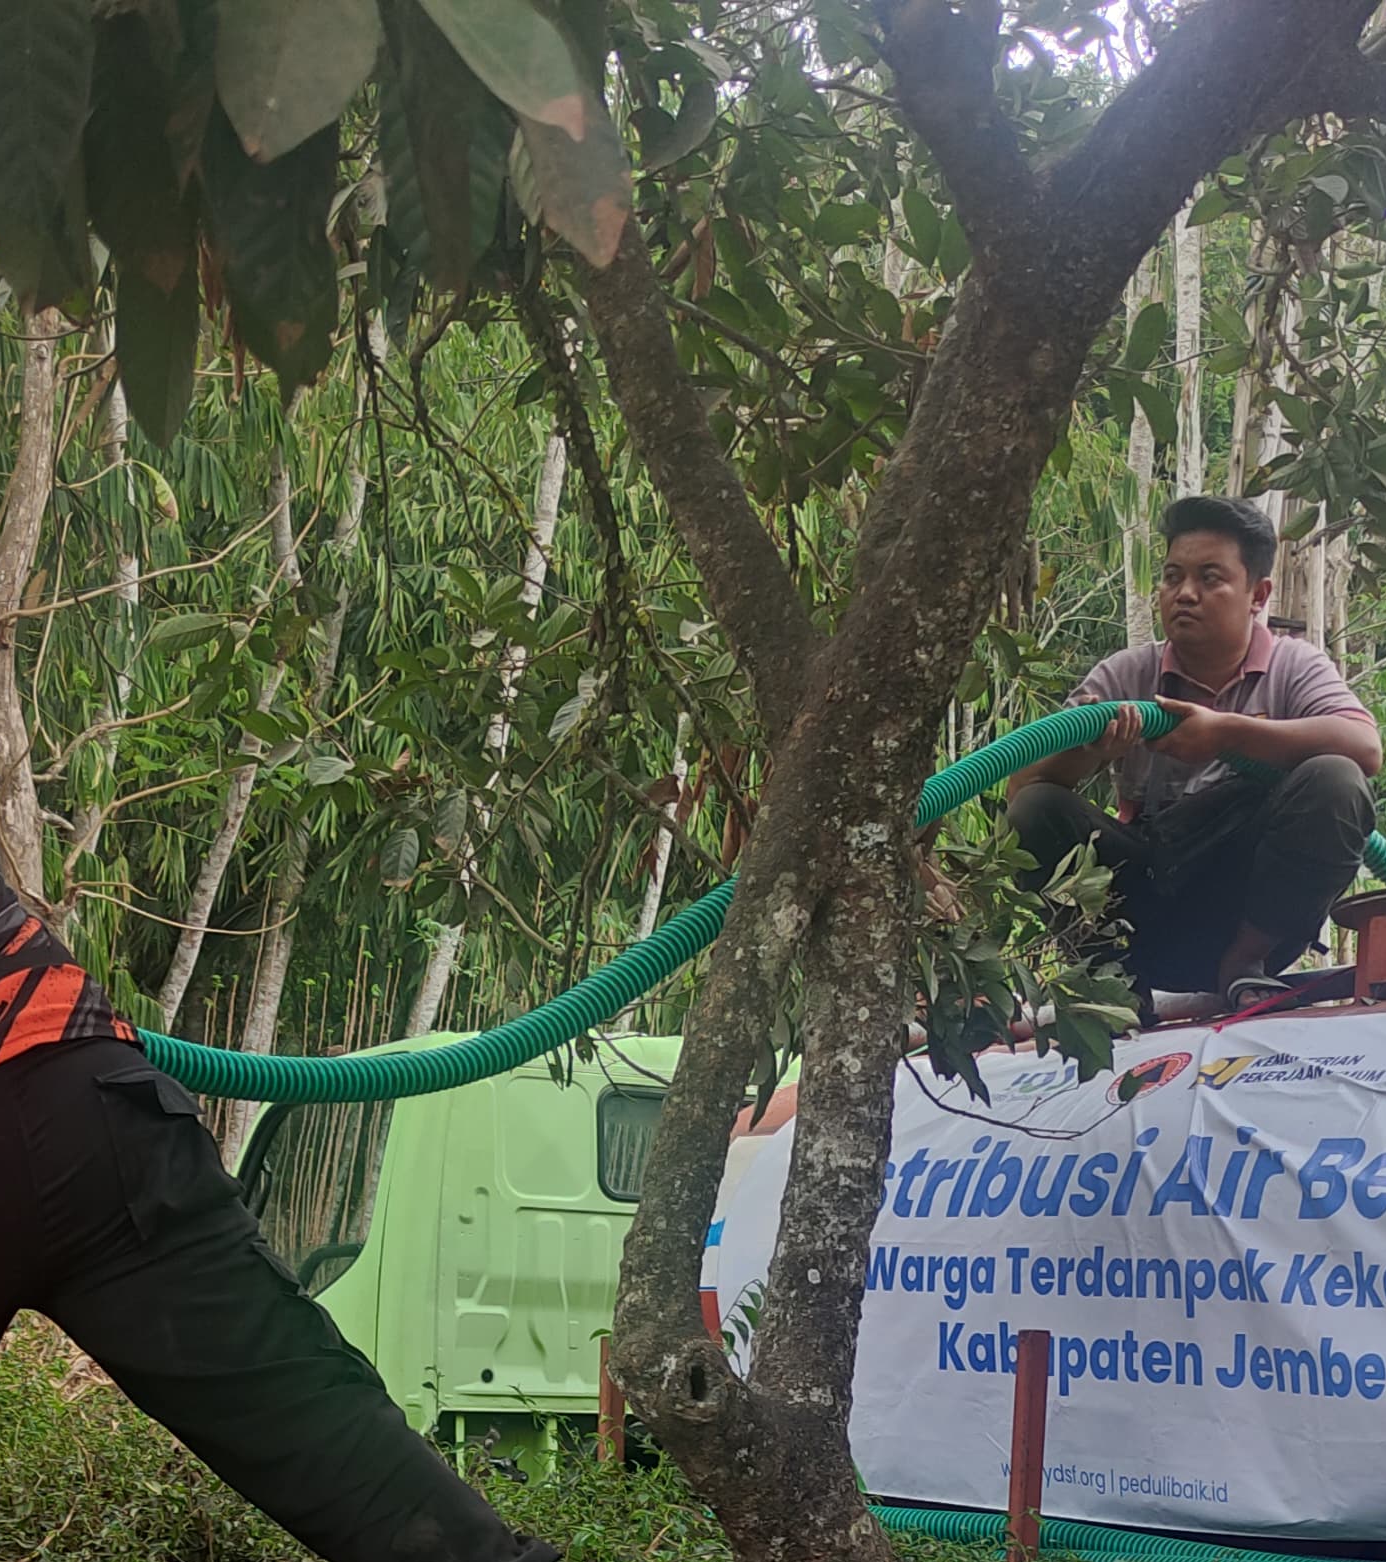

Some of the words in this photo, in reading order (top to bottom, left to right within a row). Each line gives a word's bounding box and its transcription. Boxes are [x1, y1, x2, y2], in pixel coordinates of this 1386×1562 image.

[880, 1127, 1160, 1217] tribusi
[1148, 1126, 1287, 1219] Air
[866, 1246, 996, 1310] Warga
[1006, 1246, 1277, 1318] Terdampak
[938, 1321, 1203, 1397] Kabpaten
[1000, 1463, 1106, 1495] wydsf.org
[1118, 1474, 1229, 1503] pedulibaik.id
